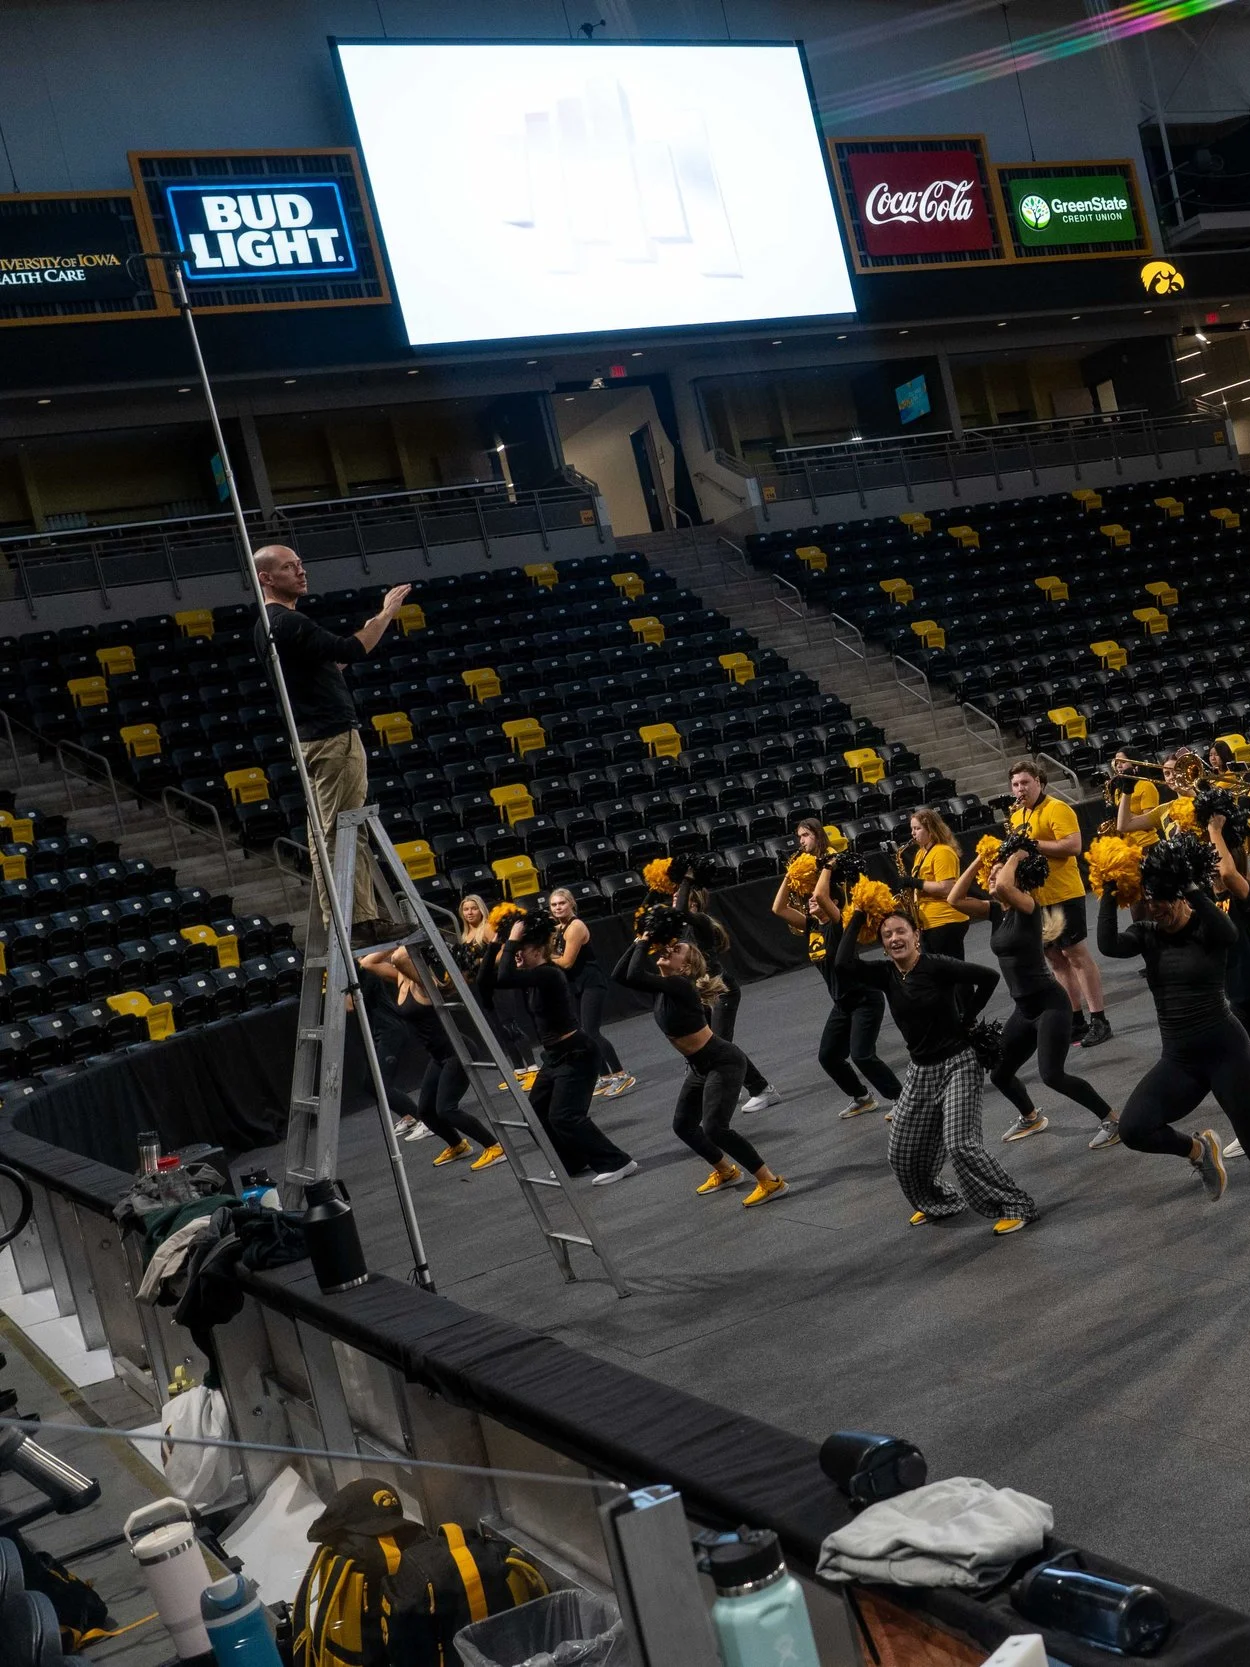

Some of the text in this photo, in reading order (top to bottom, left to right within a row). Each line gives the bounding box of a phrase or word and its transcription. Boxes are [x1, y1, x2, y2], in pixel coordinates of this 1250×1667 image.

[865, 180, 975, 225] Coca-Cola
[1051, 196, 1128, 214] GreenState
[201, 194, 313, 231] BUD
[1062, 212, 1123, 223] CREDIT UNION
[188, 228, 339, 269] LIGHT
[0, 256, 61, 271] IVERSITY
[77, 253, 121, 267] IOWA
[0, 269, 86, 285] ALTH CARE
